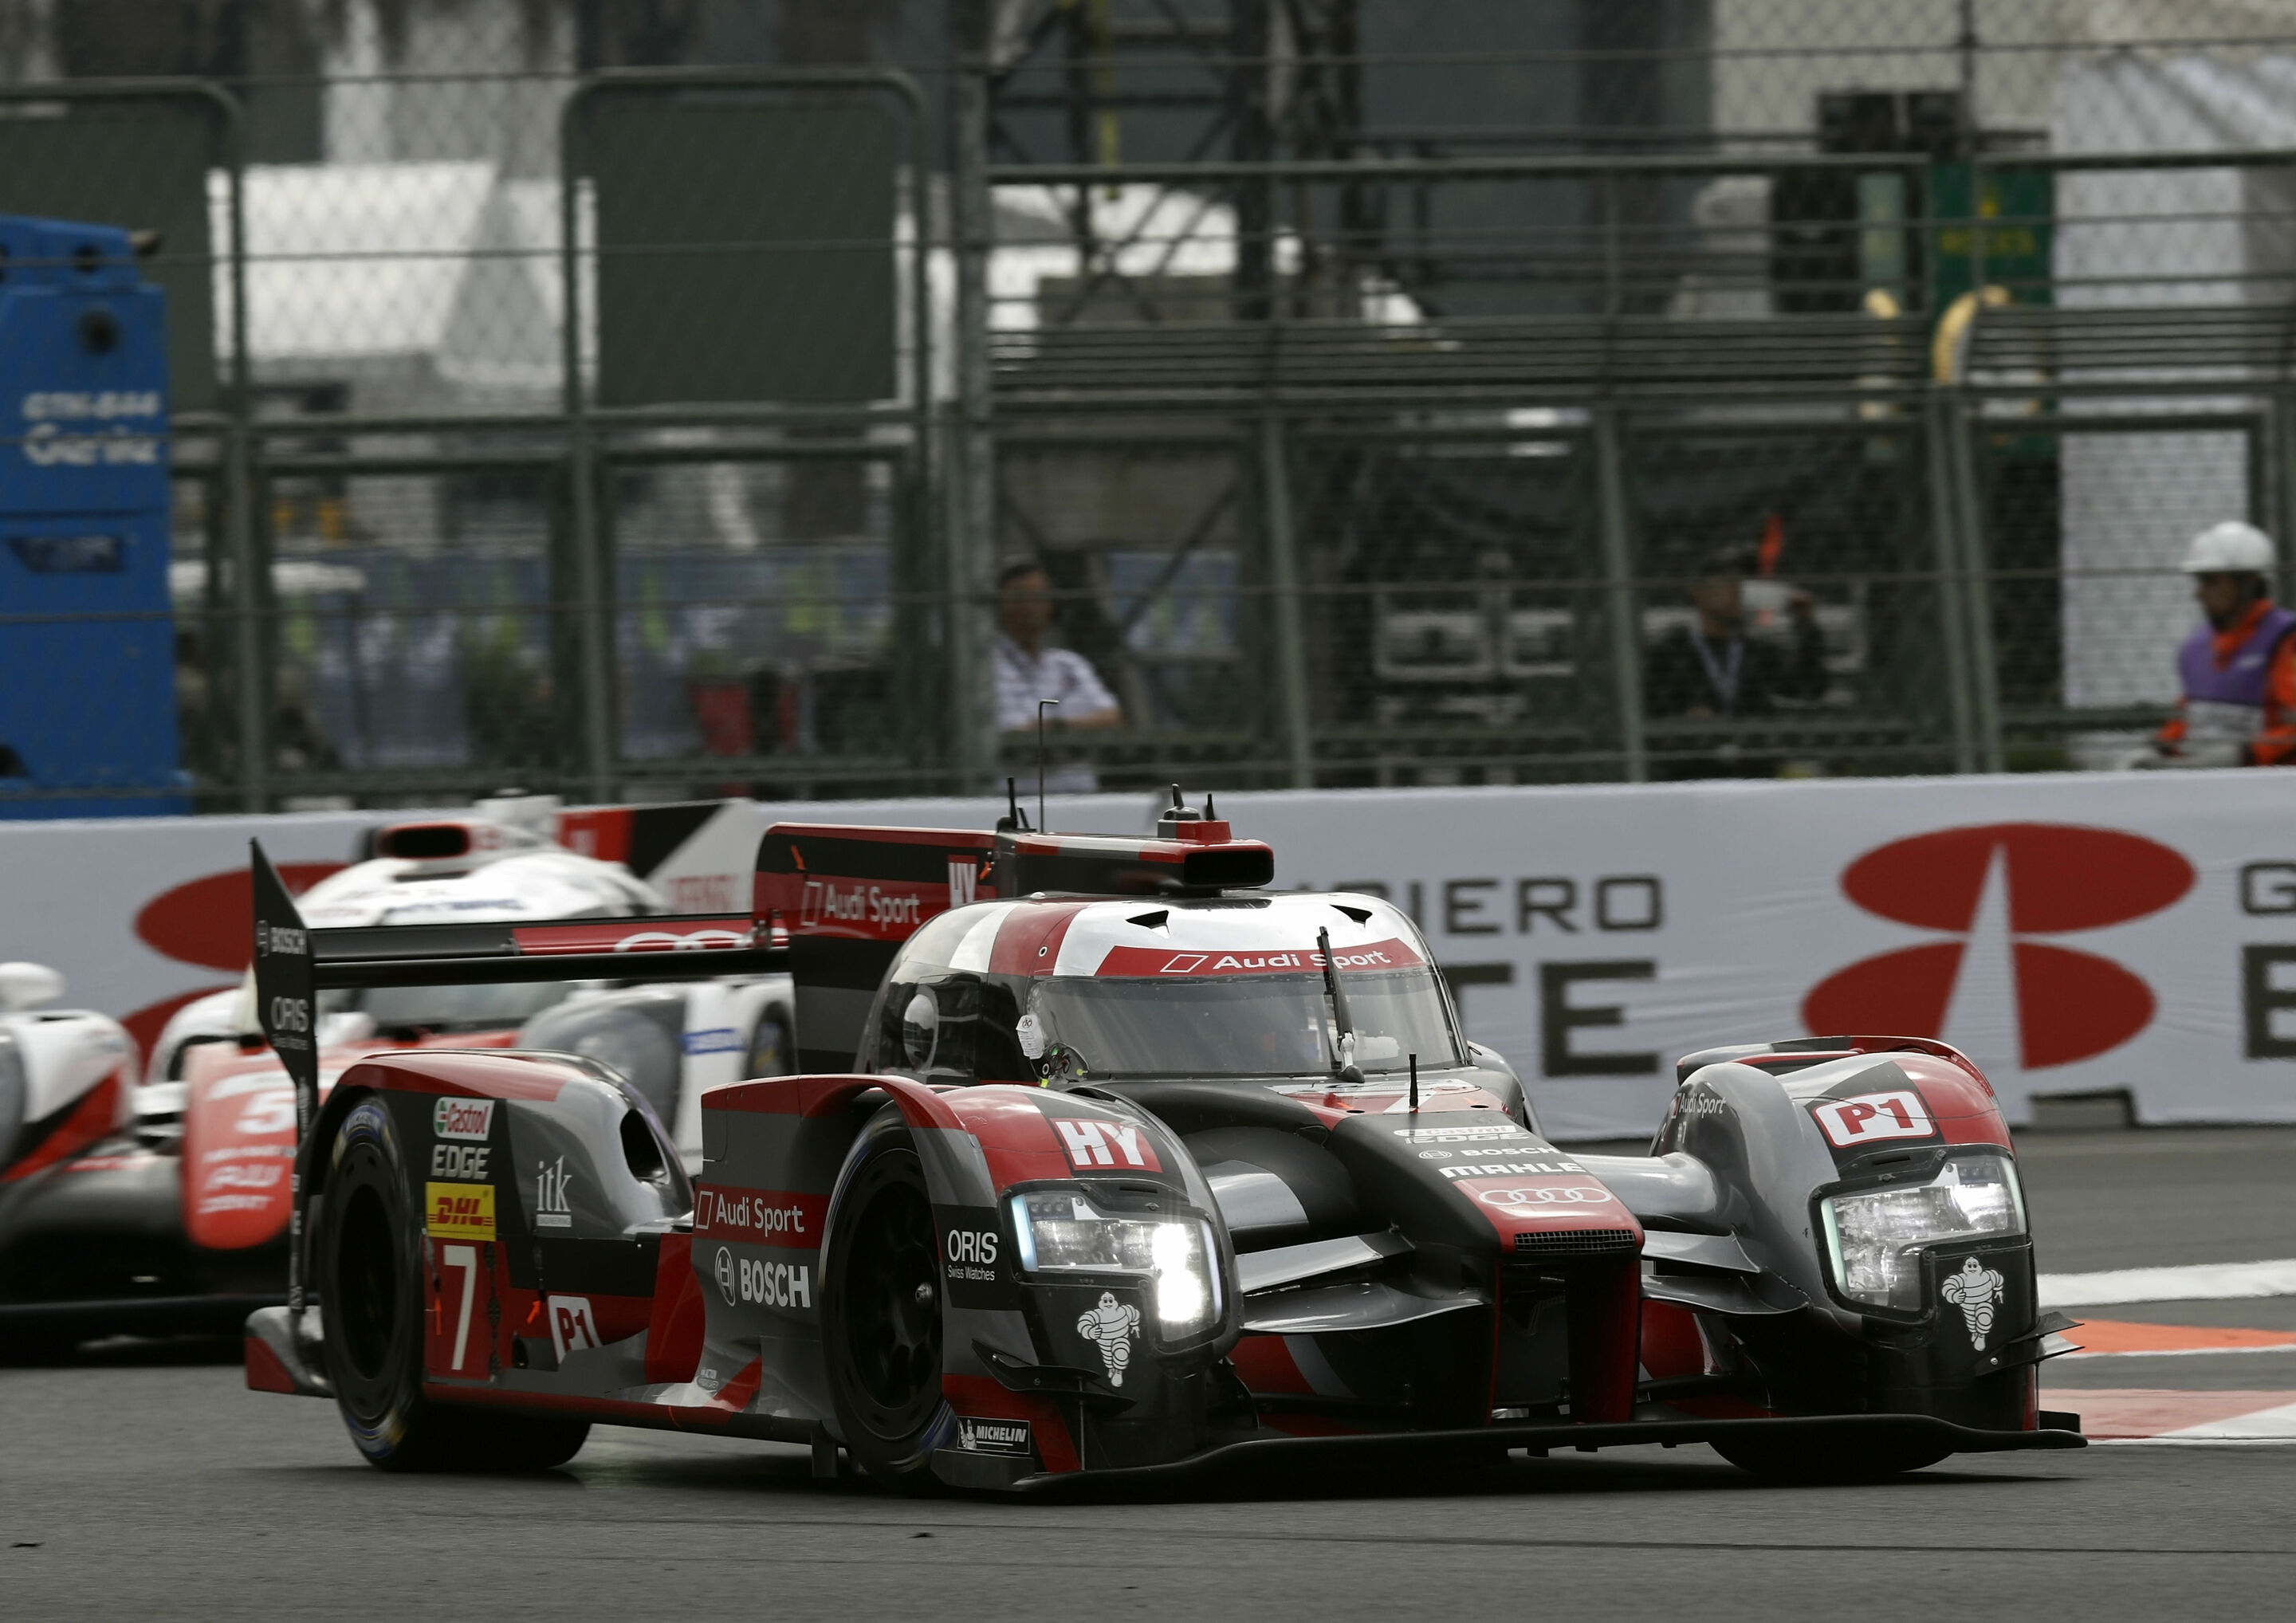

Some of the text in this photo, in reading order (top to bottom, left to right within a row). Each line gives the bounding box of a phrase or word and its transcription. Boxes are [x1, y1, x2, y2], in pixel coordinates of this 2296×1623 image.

[825, 884, 920, 931] Audi Sport
[1212, 950, 1391, 970] Audi Sport
[447, 1103, 489, 1134] Castrol
[1679, 1093, 1727, 1118] Audi Sport
[1834, 1098, 1914, 1135] P1
[1055, 1122, 1145, 1165] HY
[1406, 1133, 1530, 1145] EDGE
[1460, 1146, 1563, 1157] BOSCH
[431, 1145, 491, 1180] EDGE
[537, 1154, 572, 1212] itk
[436, 1197, 483, 1226] DHL
[716, 1193, 805, 1238] Audi Sport
[947, 1229, 998, 1264] ORIS
[740, 1258, 811, 1308] BOSCH
[947, 1264, 996, 1281] Swiss Watches
[443, 1245, 477, 1370] 7
[556, 1307, 596, 1353] P1
[976, 1425, 1027, 1442] MICHELIN
